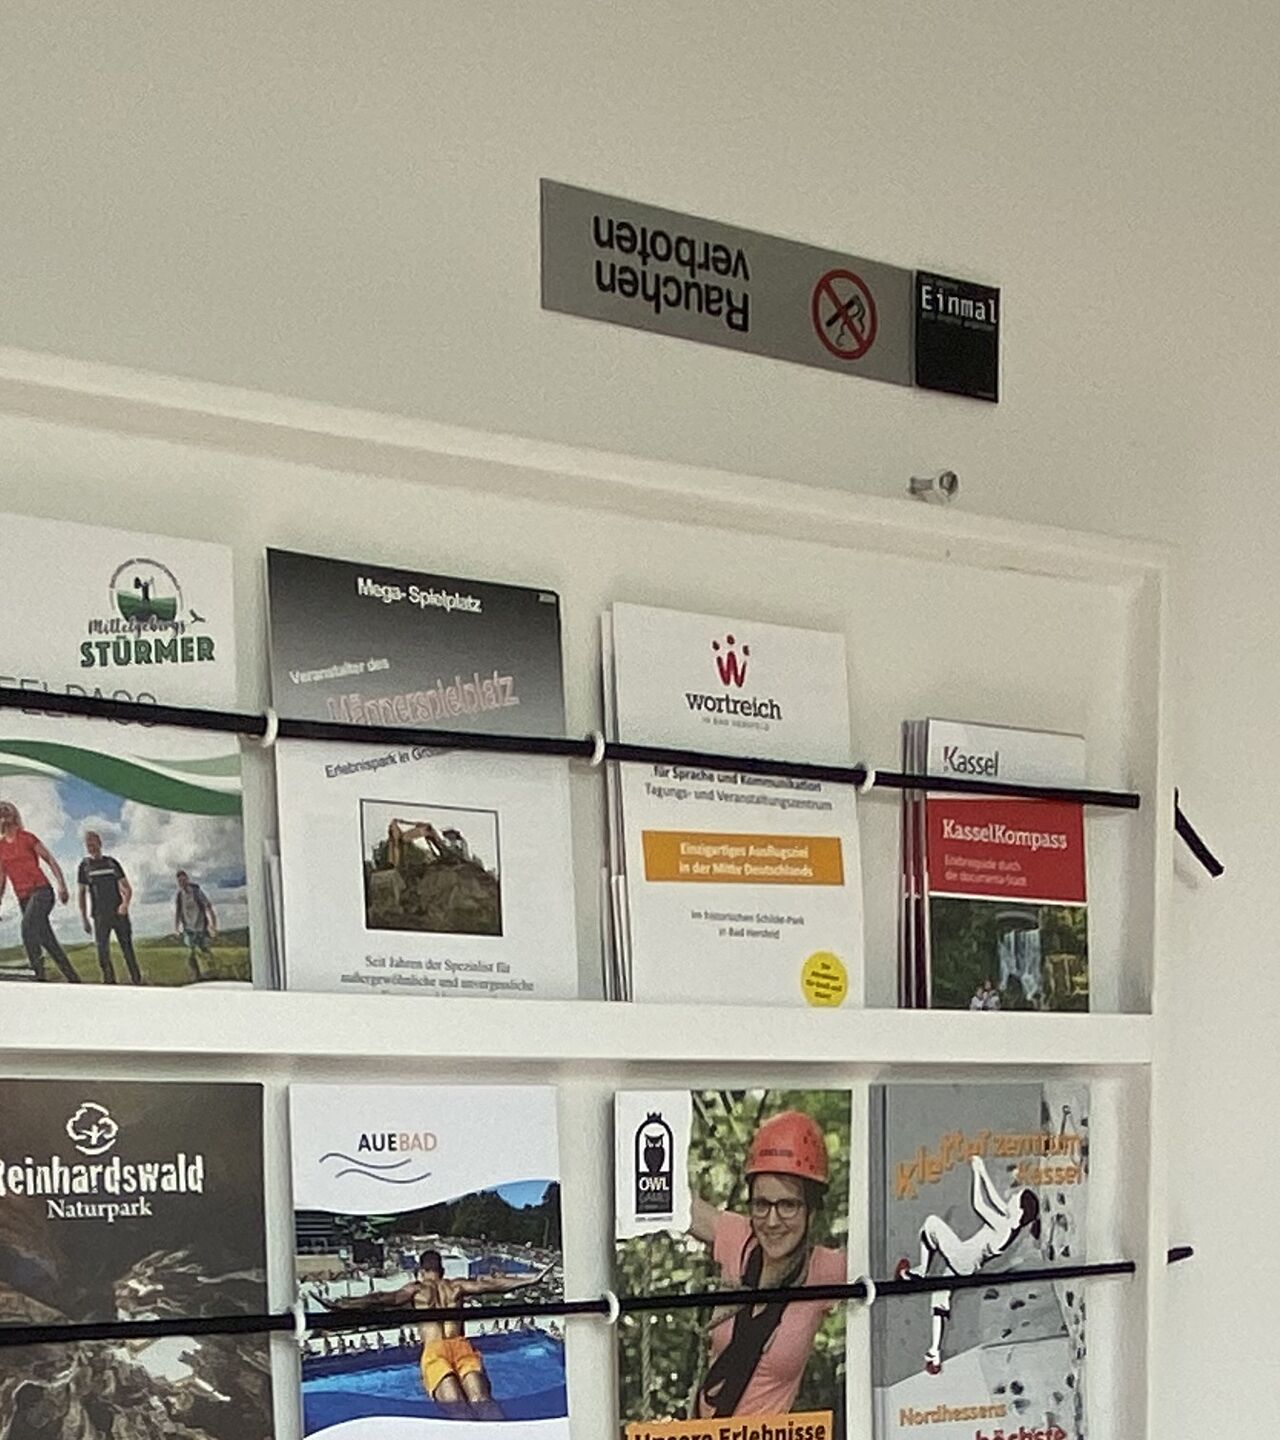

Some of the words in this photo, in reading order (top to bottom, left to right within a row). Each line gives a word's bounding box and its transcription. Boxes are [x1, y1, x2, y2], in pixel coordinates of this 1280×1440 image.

[593, 215, 750, 281] verboten
[594, 259, 750, 333] Rauchen
[921, 285, 997, 324] Einmal
[79, 636, 215, 668] STÜRMER
[685, 693, 782, 720] wortreich
[944, 745, 999, 776] Kassel
[645, 783, 691, 800] Tagungs-
[694, 788, 715, 801] und
[654, 766, 670, 778] für
[672, 766, 715, 785] Sprache
[717, 771, 738, 785] und
[740, 774, 822, 793] Kommunikation
[942, 818, 1068, 850] KasselKompass
[358, 1133, 437, 1151] AUEBAD
[638, 1176, 669, 1192] OWL
[46, 1196, 153, 1223] Naturpark
[899, 1403, 1007, 1427] Nordhessens
